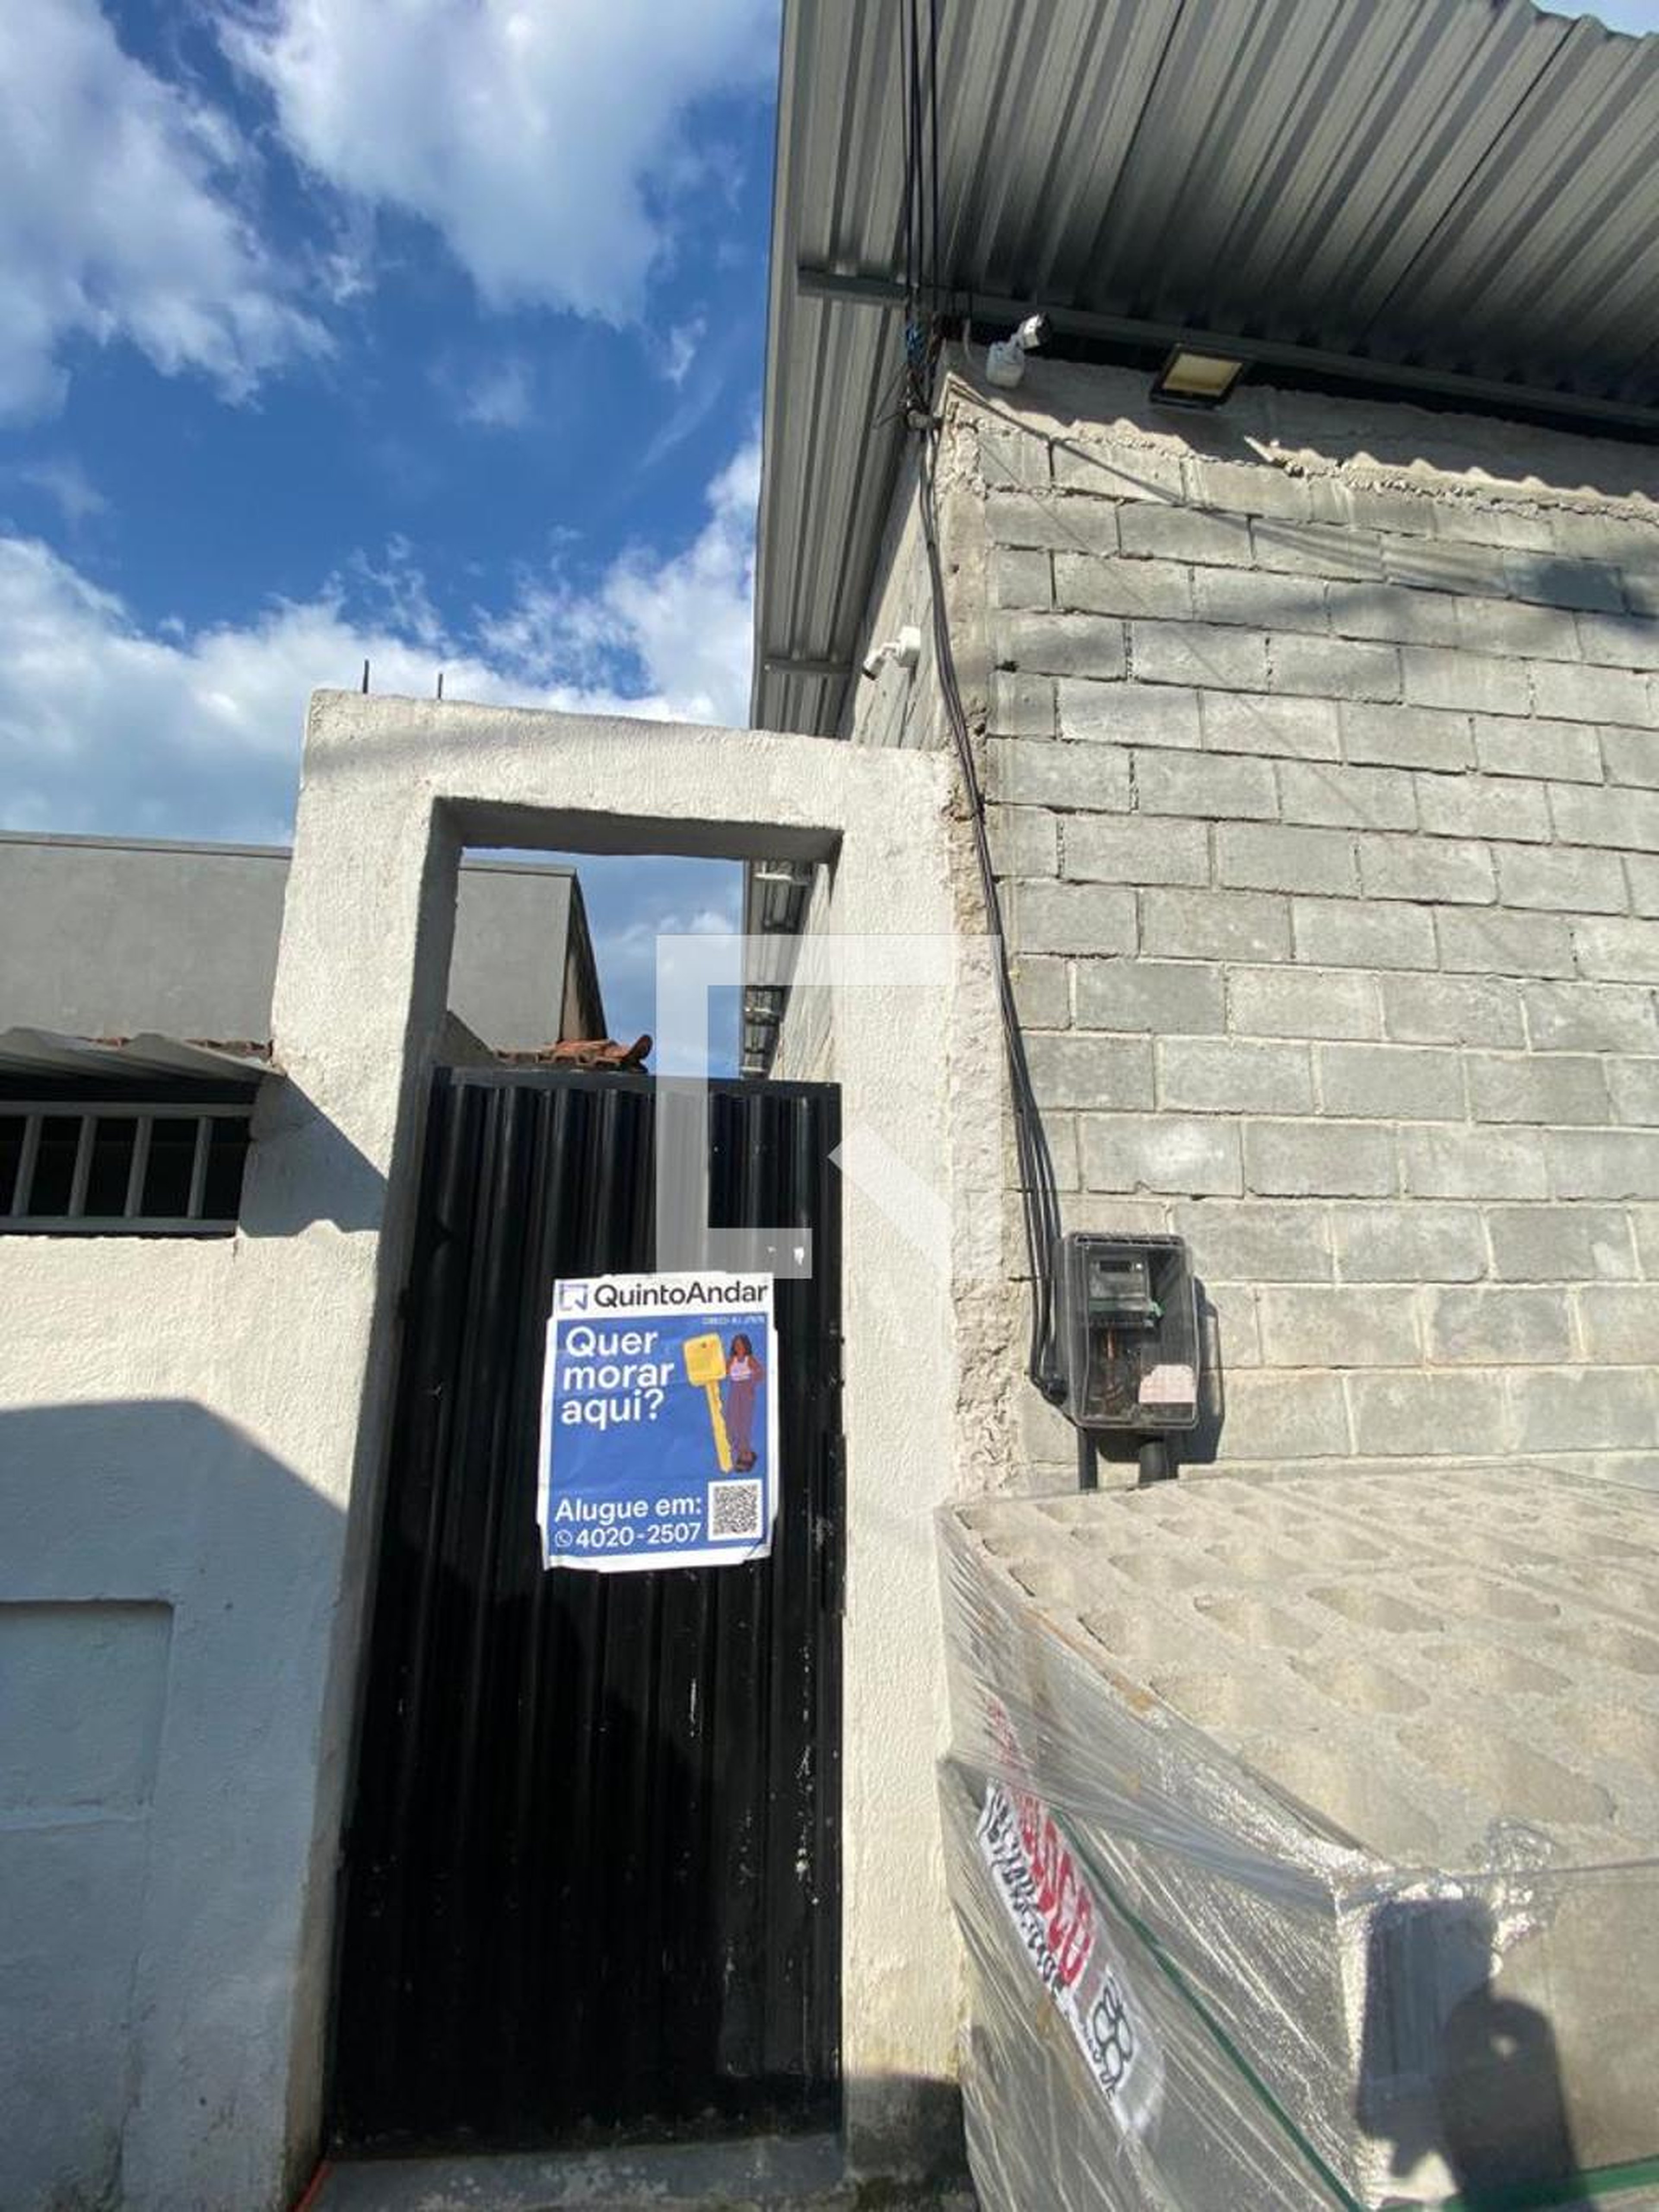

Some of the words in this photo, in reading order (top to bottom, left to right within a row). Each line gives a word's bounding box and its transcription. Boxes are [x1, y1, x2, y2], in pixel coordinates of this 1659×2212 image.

[594, 1281, 769, 1308] QuintoAndar
[567, 1326, 658, 1358] Quer
[563, 1362, 674, 1390] morar
[562, 1391, 664, 1429] aqui?
[555, 1498, 647, 1525] Alugue
[655, 1497, 702, 1516] em:
[576, 1523, 701, 1548] 4020-2507
